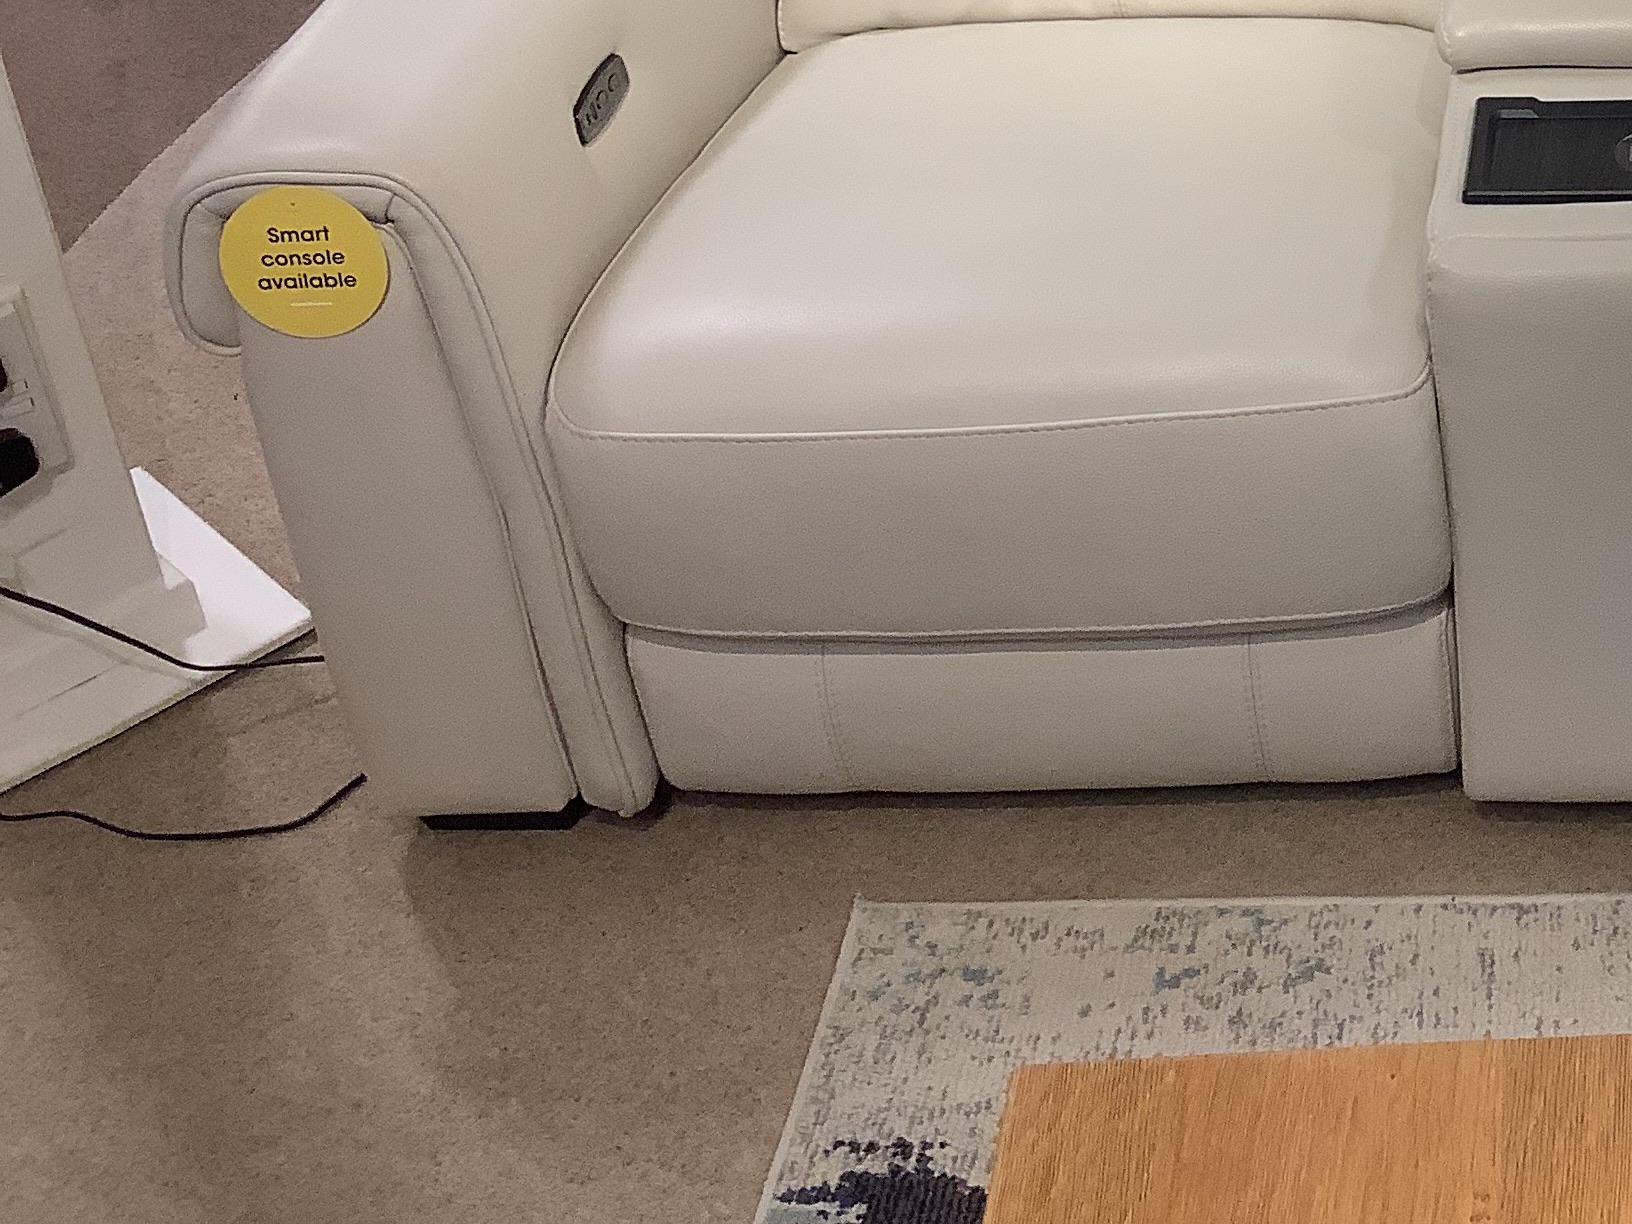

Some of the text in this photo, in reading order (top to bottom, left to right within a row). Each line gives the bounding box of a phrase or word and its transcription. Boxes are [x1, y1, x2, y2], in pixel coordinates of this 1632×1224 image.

[266, 226, 330, 243] Smart
[261, 249, 345, 267] console
[257, 272, 357, 290] available
